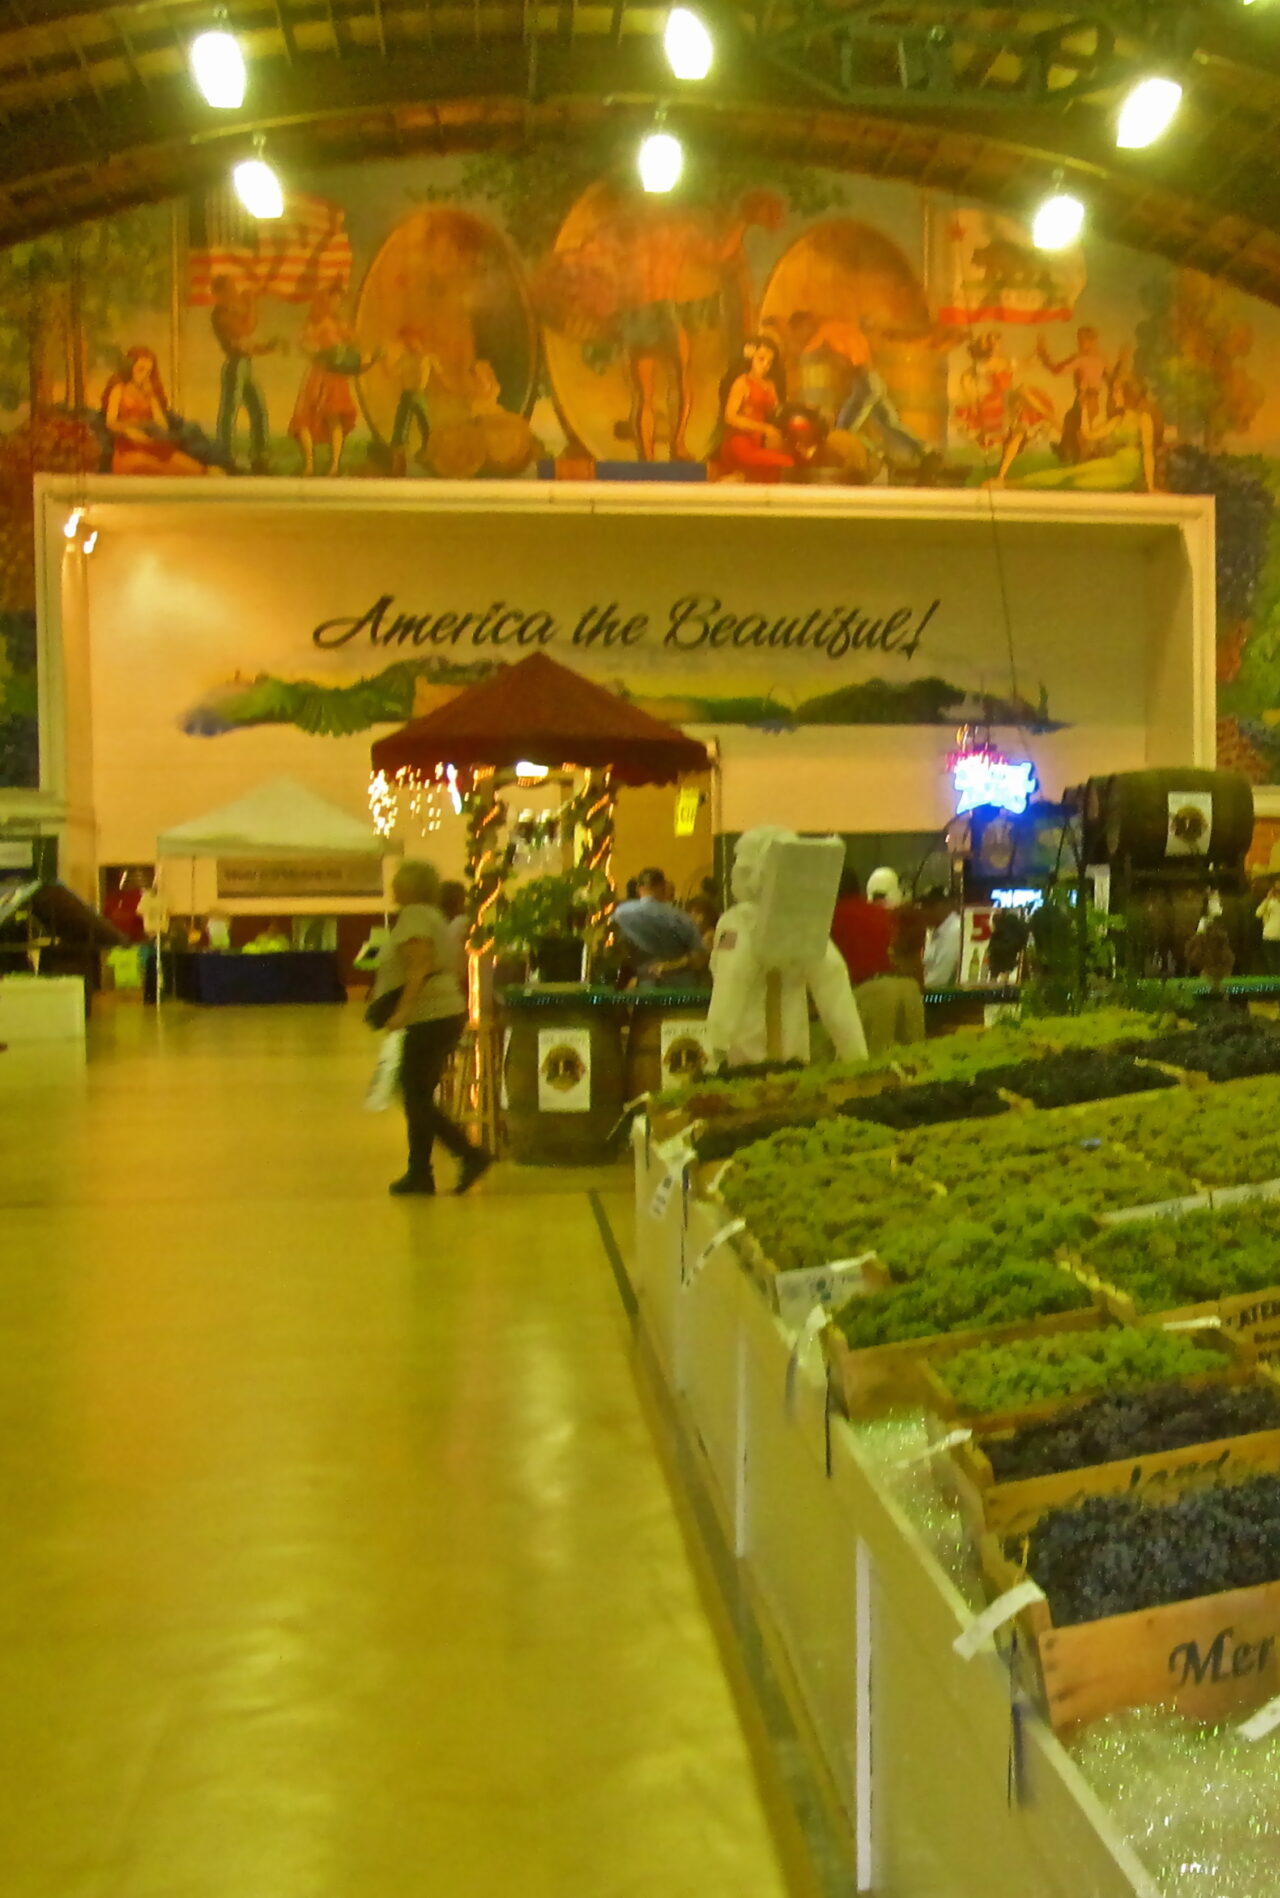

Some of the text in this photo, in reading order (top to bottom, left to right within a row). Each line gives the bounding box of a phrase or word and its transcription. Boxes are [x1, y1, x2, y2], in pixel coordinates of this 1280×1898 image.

[312, 593, 941, 661] America the Beautiful!
